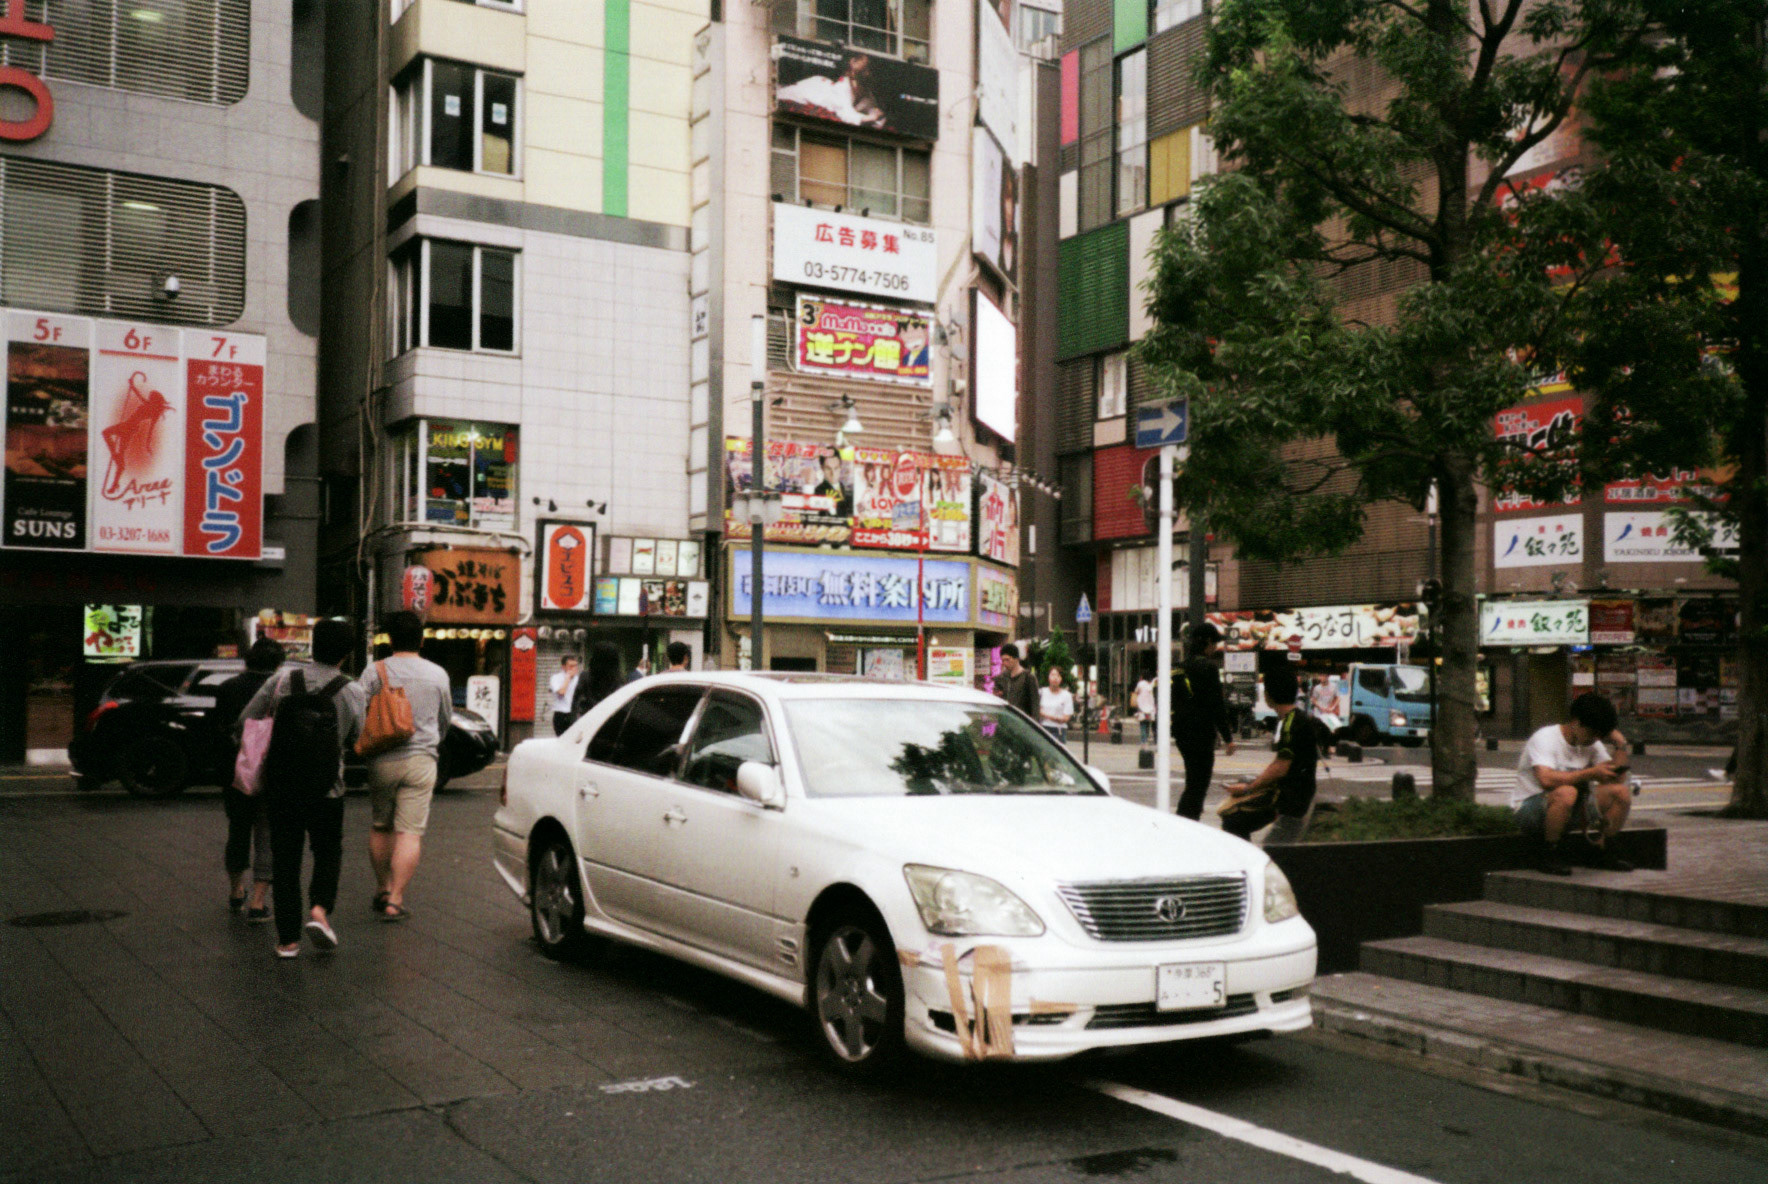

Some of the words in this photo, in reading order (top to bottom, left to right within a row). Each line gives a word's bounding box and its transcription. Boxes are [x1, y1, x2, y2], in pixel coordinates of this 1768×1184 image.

[815, 223, 900, 254] 広告募集
[804, 261, 909, 291] 03-5774-7506
[33, 318, 62, 341] 5F
[123, 329, 153, 350] 6F
[211, 337, 238, 360] 7F
[432, 432, 469, 449] KING
[201, 393, 247, 554] ゴンドラ
[13, 519, 77, 539] SUNS
